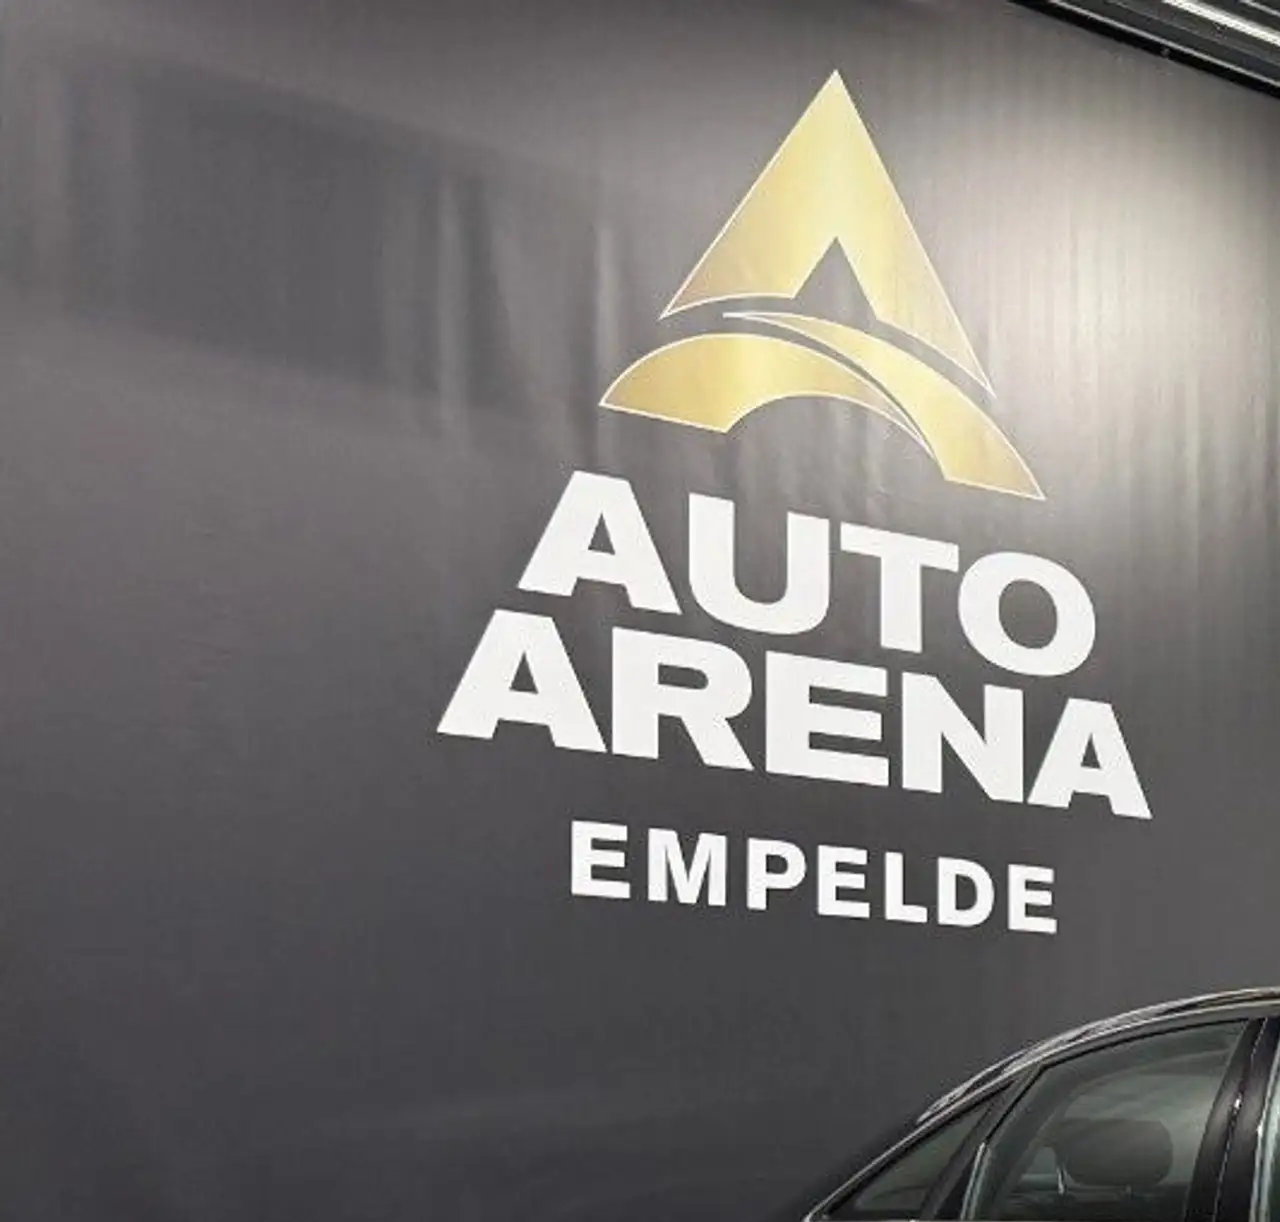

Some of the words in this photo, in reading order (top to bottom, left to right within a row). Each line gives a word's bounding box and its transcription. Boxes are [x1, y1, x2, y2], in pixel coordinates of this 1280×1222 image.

[518, 470, 1096, 677] AUTO
[436, 609, 1152, 819] ARENA
[571, 821, 1057, 934] EMPELDE
